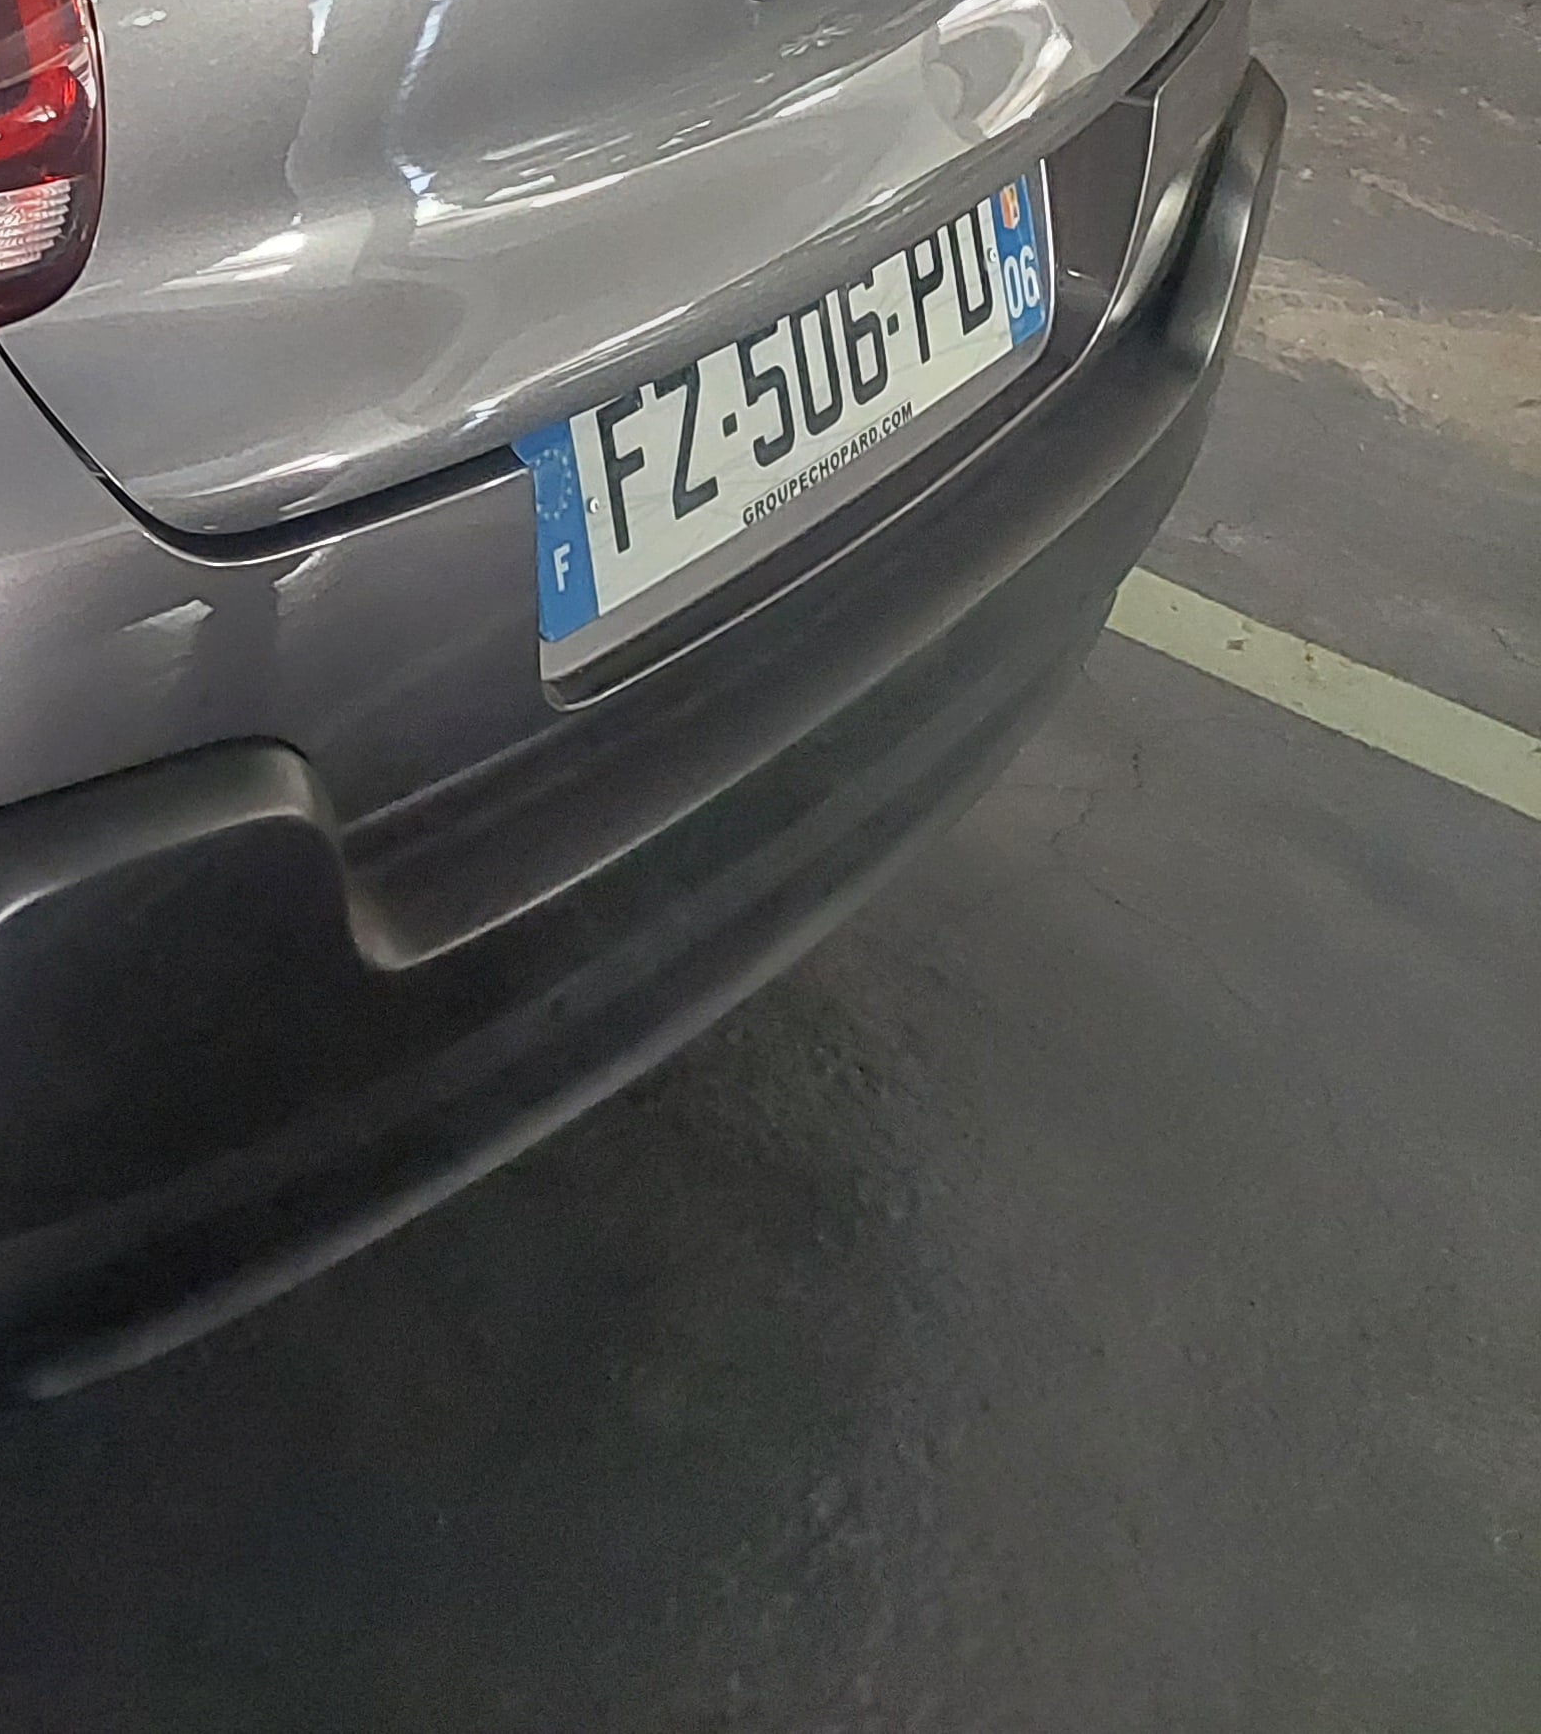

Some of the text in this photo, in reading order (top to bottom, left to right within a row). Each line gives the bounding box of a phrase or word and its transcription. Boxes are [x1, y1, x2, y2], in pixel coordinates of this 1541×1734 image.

[1004, 246, 1041, 318] 06
[742, 401, 914, 526] GROUPECHOPARD.COM
[553, 543, 571, 593] F
